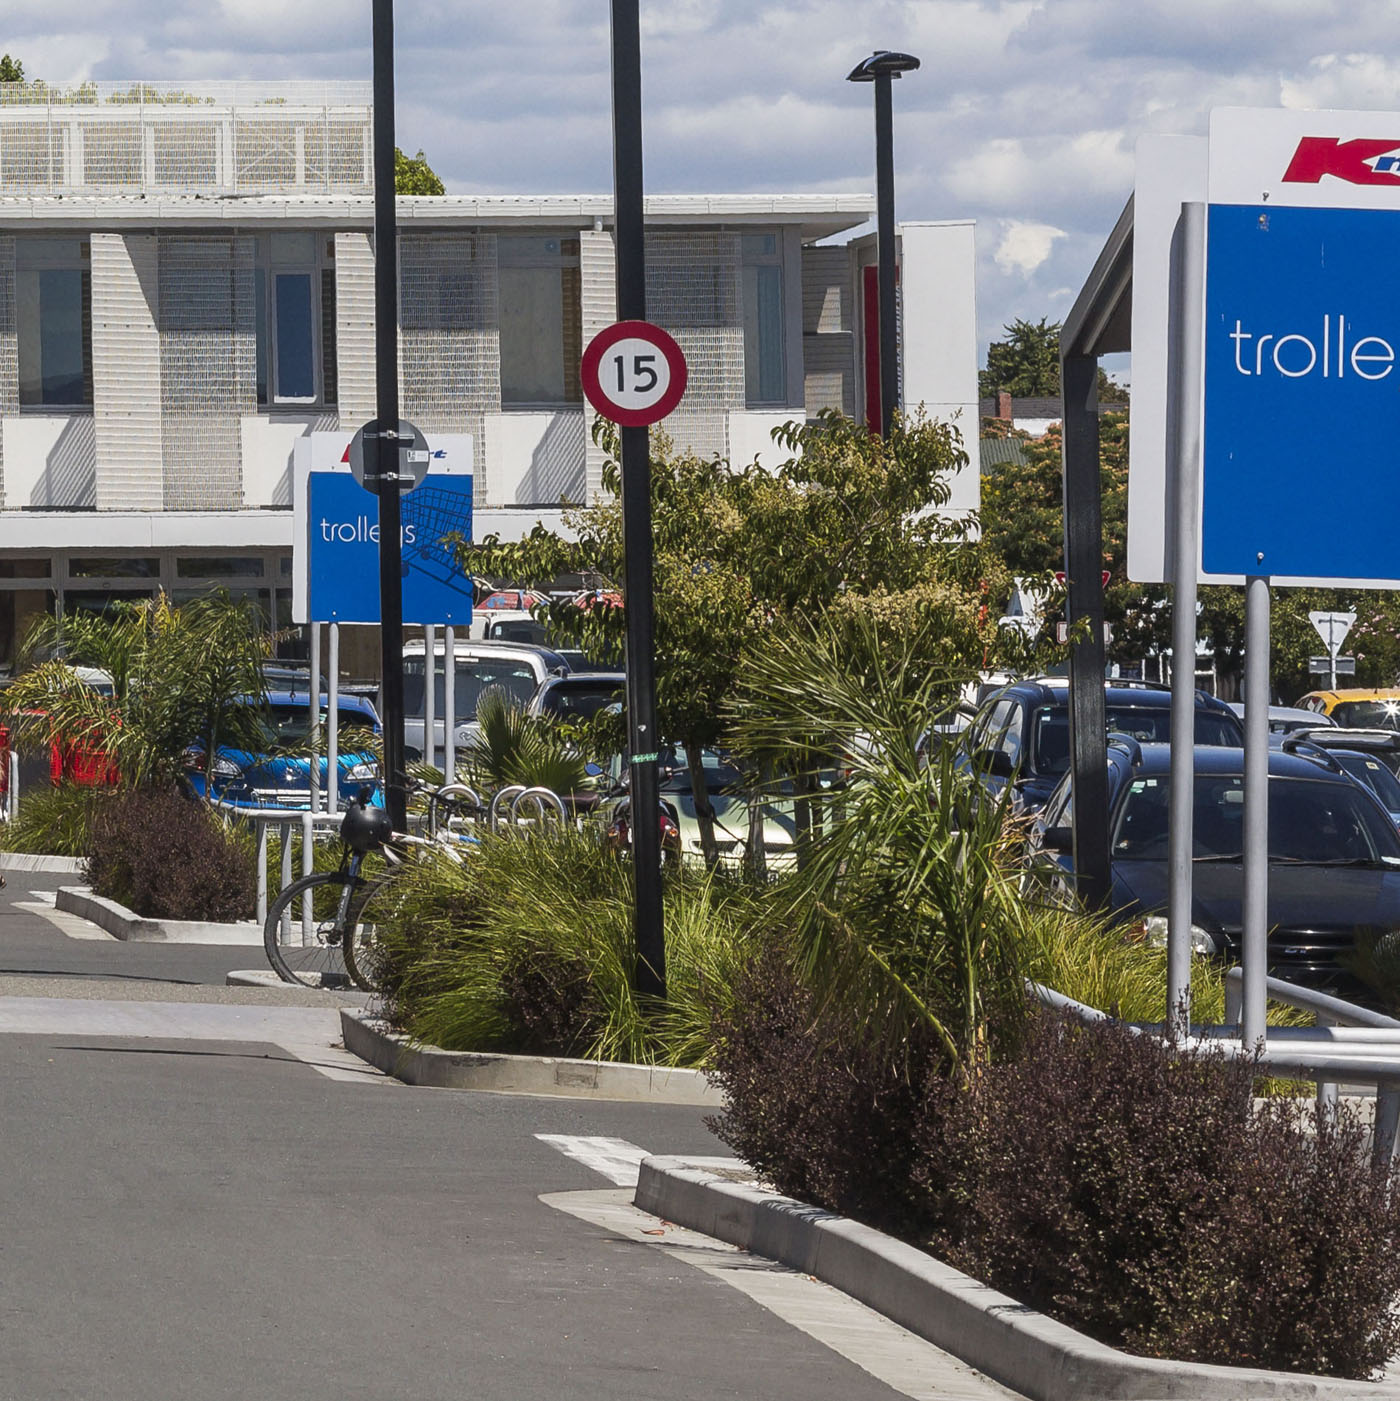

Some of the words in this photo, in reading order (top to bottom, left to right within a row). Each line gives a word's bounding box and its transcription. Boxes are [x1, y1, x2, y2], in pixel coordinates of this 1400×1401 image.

[1281, 136, 1400, 186] K
[613, 355, 658, 393] 15
[320, 515, 416, 548] trolles
